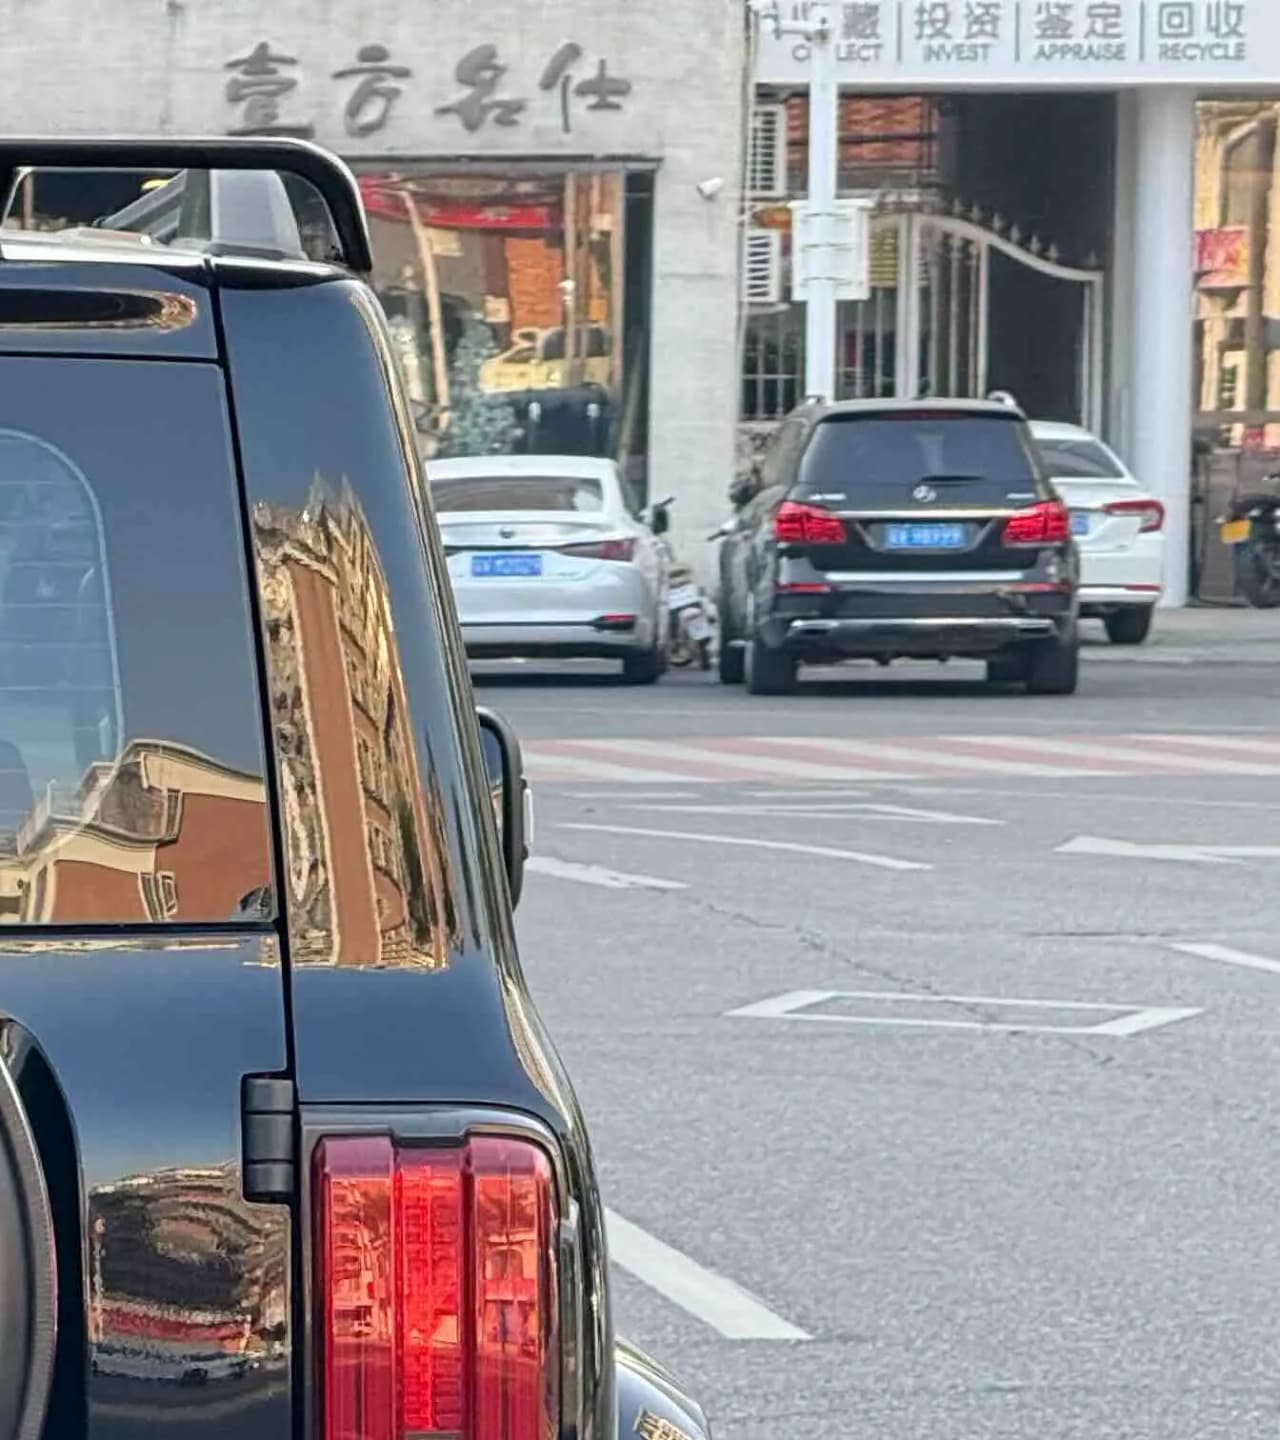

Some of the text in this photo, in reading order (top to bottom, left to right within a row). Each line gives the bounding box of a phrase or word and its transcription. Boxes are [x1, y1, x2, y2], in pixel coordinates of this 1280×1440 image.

[915, 2, 1000, 40] 投资
[1035, 1, 1123, 39] 鉴定
[1158, 2, 1245, 38] 回收
[791, 43, 1245, 62] CLECT INVEST APPRAISE RECYCLE
